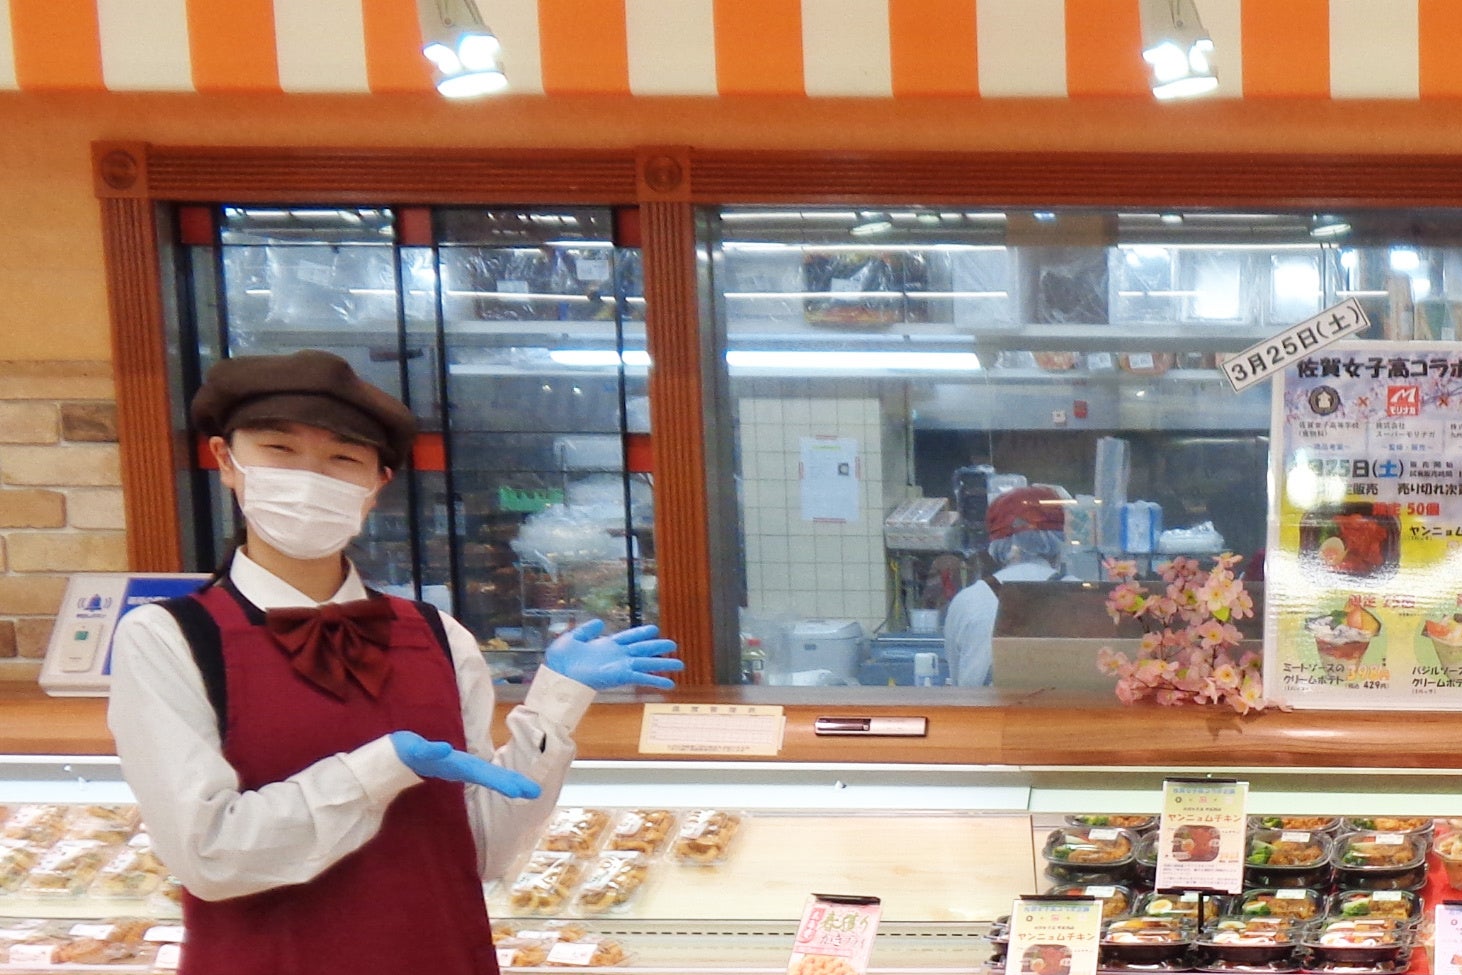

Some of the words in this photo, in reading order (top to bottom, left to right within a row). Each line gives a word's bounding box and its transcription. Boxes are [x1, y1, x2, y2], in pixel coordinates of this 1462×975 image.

[1231, 306, 1362, 382] 3月25日(土)
[1283, 663, 1345, 673] ミートソースの
[1283, 675, 1344, 685] クリームポテト
[1168, 814, 1241, 822] ヤンニョムチキン
[1018, 932, 1095, 941] ヤンニョムチキン
